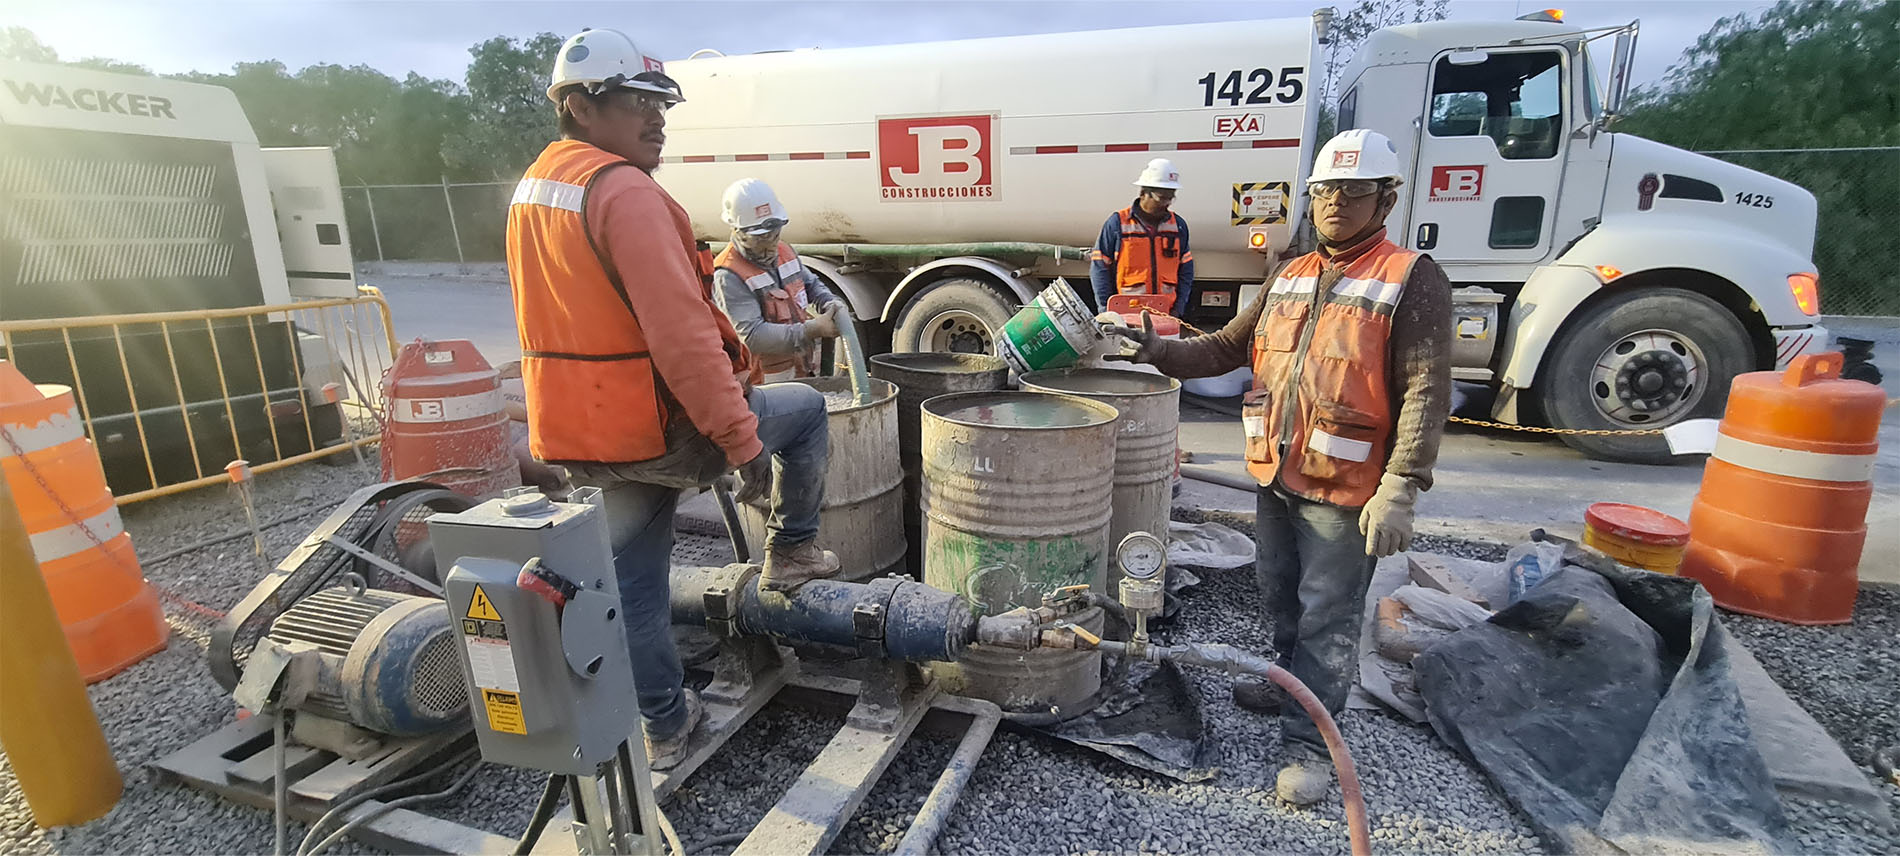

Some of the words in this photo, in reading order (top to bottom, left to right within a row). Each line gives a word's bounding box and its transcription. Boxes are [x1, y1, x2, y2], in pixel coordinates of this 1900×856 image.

[1198, 66, 1304, 107] 1425
[3, 79, 177, 120] WACKER
[1216, 113, 1260, 137] EXA
[888, 125, 983, 187] JB
[882, 186, 992, 198] CONSTRUCCIONES
[1433, 170, 1480, 197] JB
[1735, 191, 1775, 209] 1425
[413, 401, 442, 418] JB
